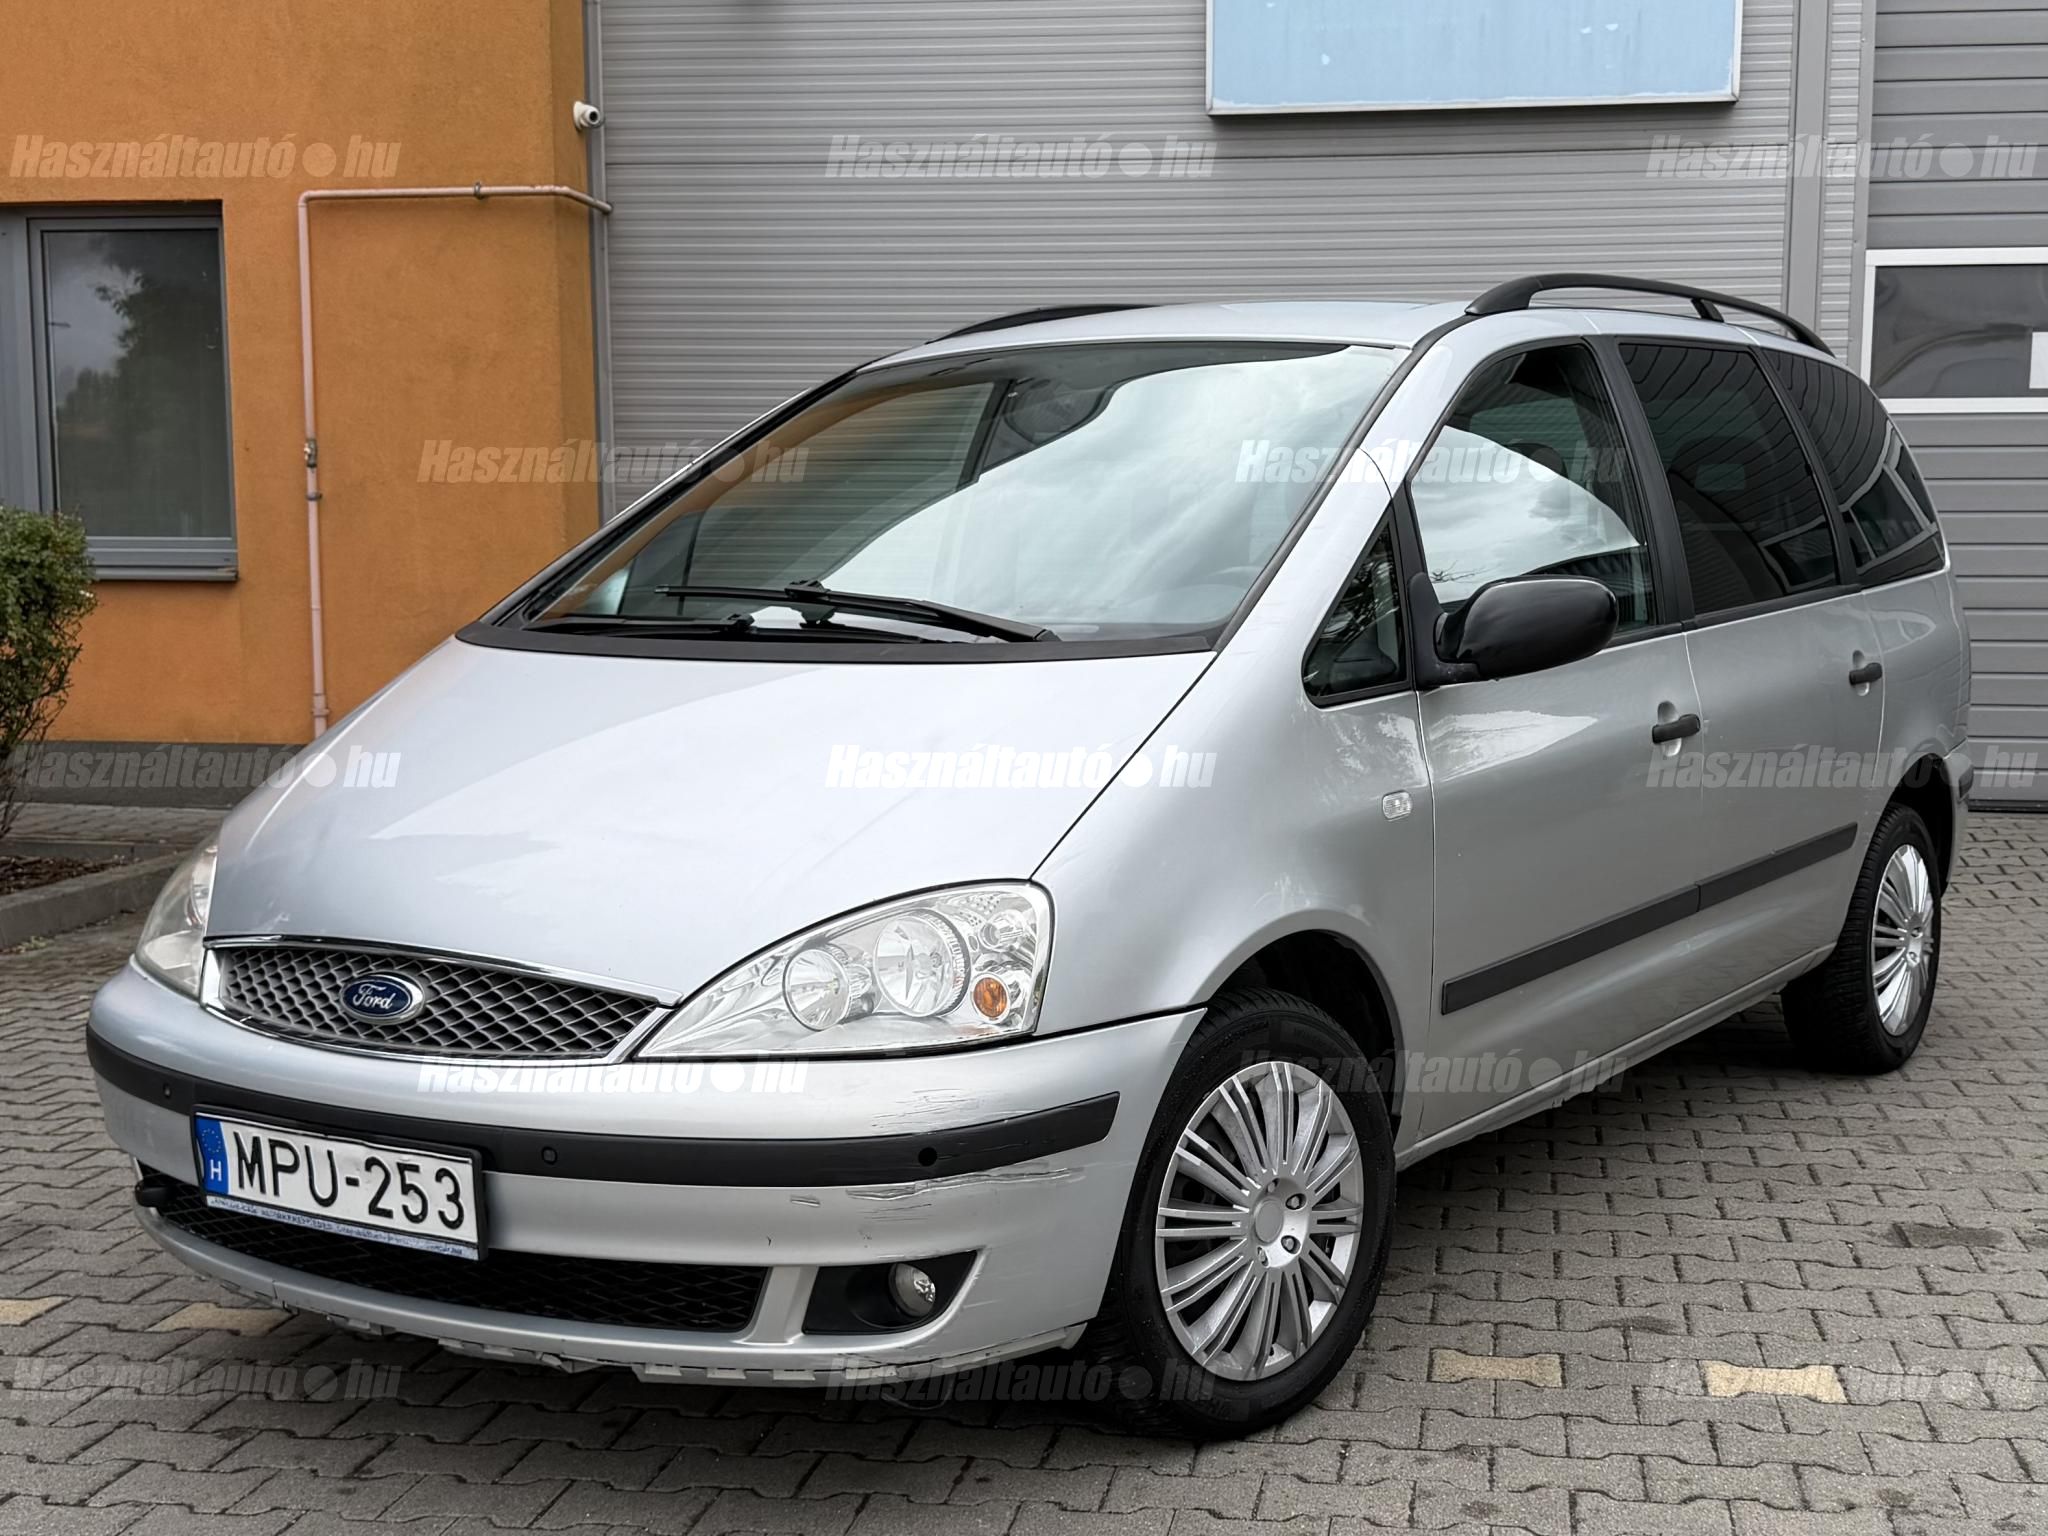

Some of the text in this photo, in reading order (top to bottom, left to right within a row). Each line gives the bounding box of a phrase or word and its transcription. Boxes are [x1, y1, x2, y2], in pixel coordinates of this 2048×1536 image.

[352, 983, 396, 1010] Ford
[209, 1159, 222, 1182] H
[233, 1131, 465, 1230] MPU-253
